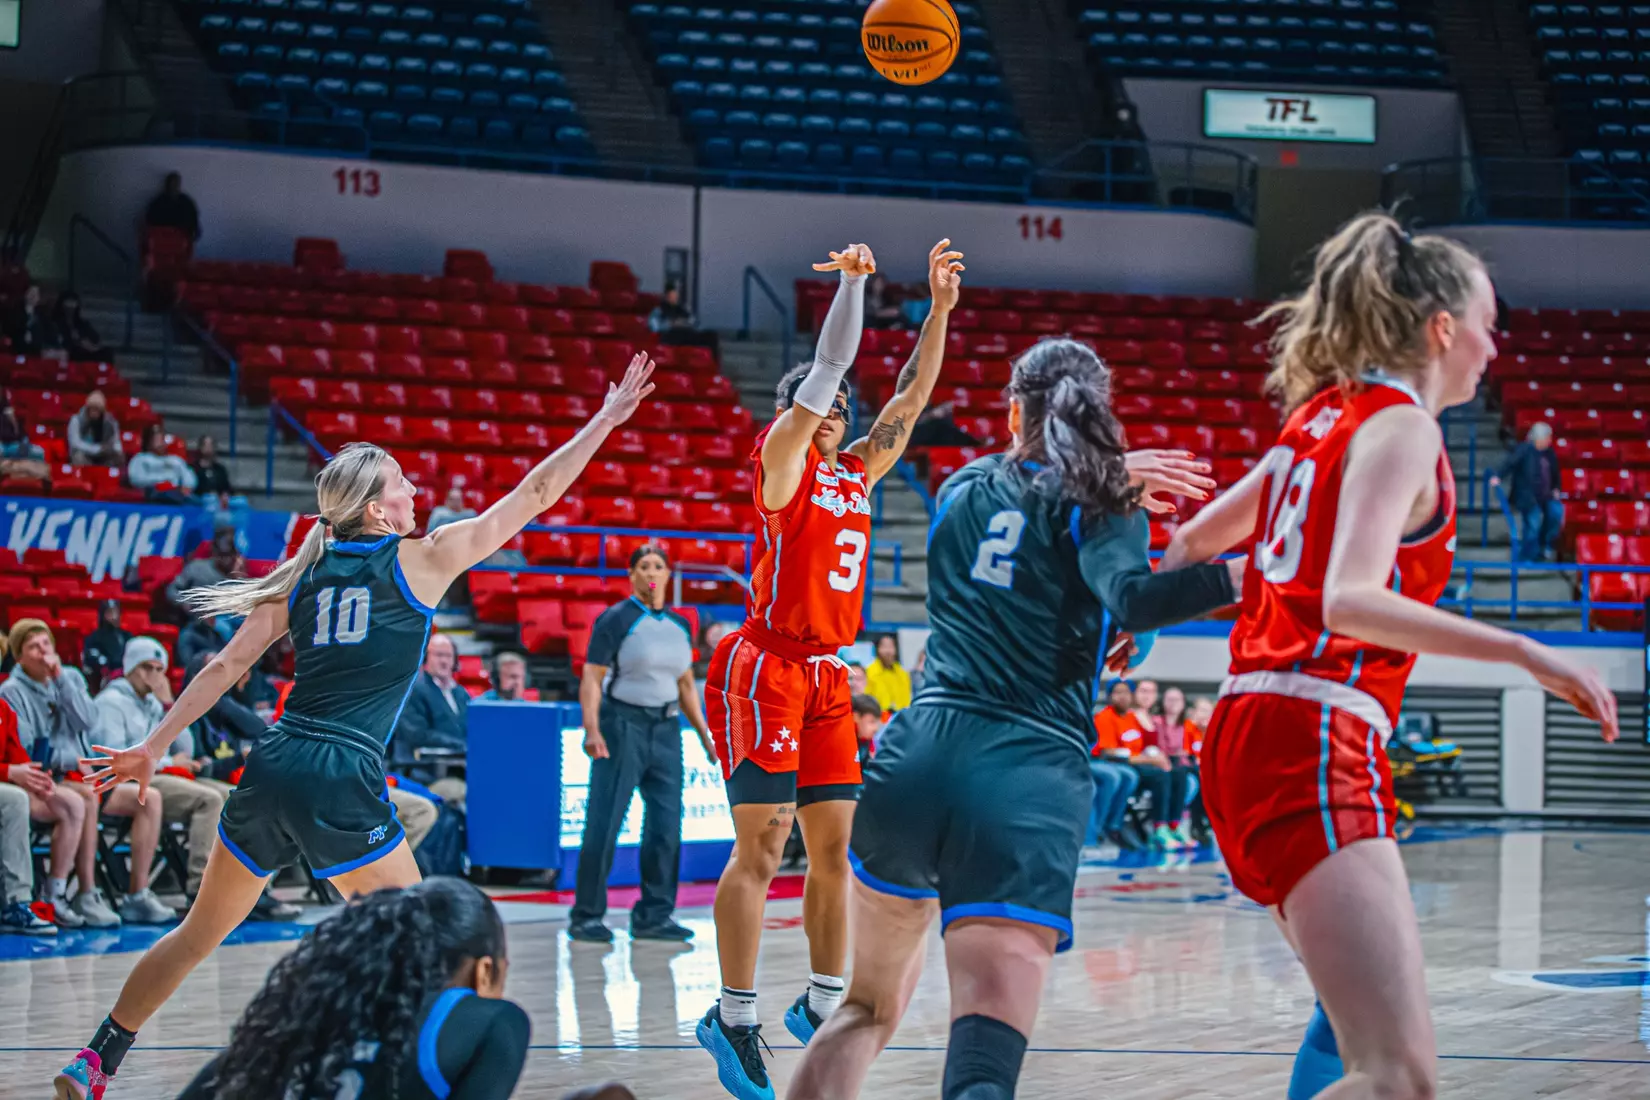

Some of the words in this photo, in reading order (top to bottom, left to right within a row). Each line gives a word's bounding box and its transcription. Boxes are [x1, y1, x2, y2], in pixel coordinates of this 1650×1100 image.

[866, 32, 929, 52] Wilson
[1264, 98, 1318, 122] TFL
[332, 167, 381, 198] 113
[1016, 214, 1063, 241] 114
[828, 528, 867, 593] 3
[971, 510, 1027, 589] 2
[312, 586, 372, 646] 10
